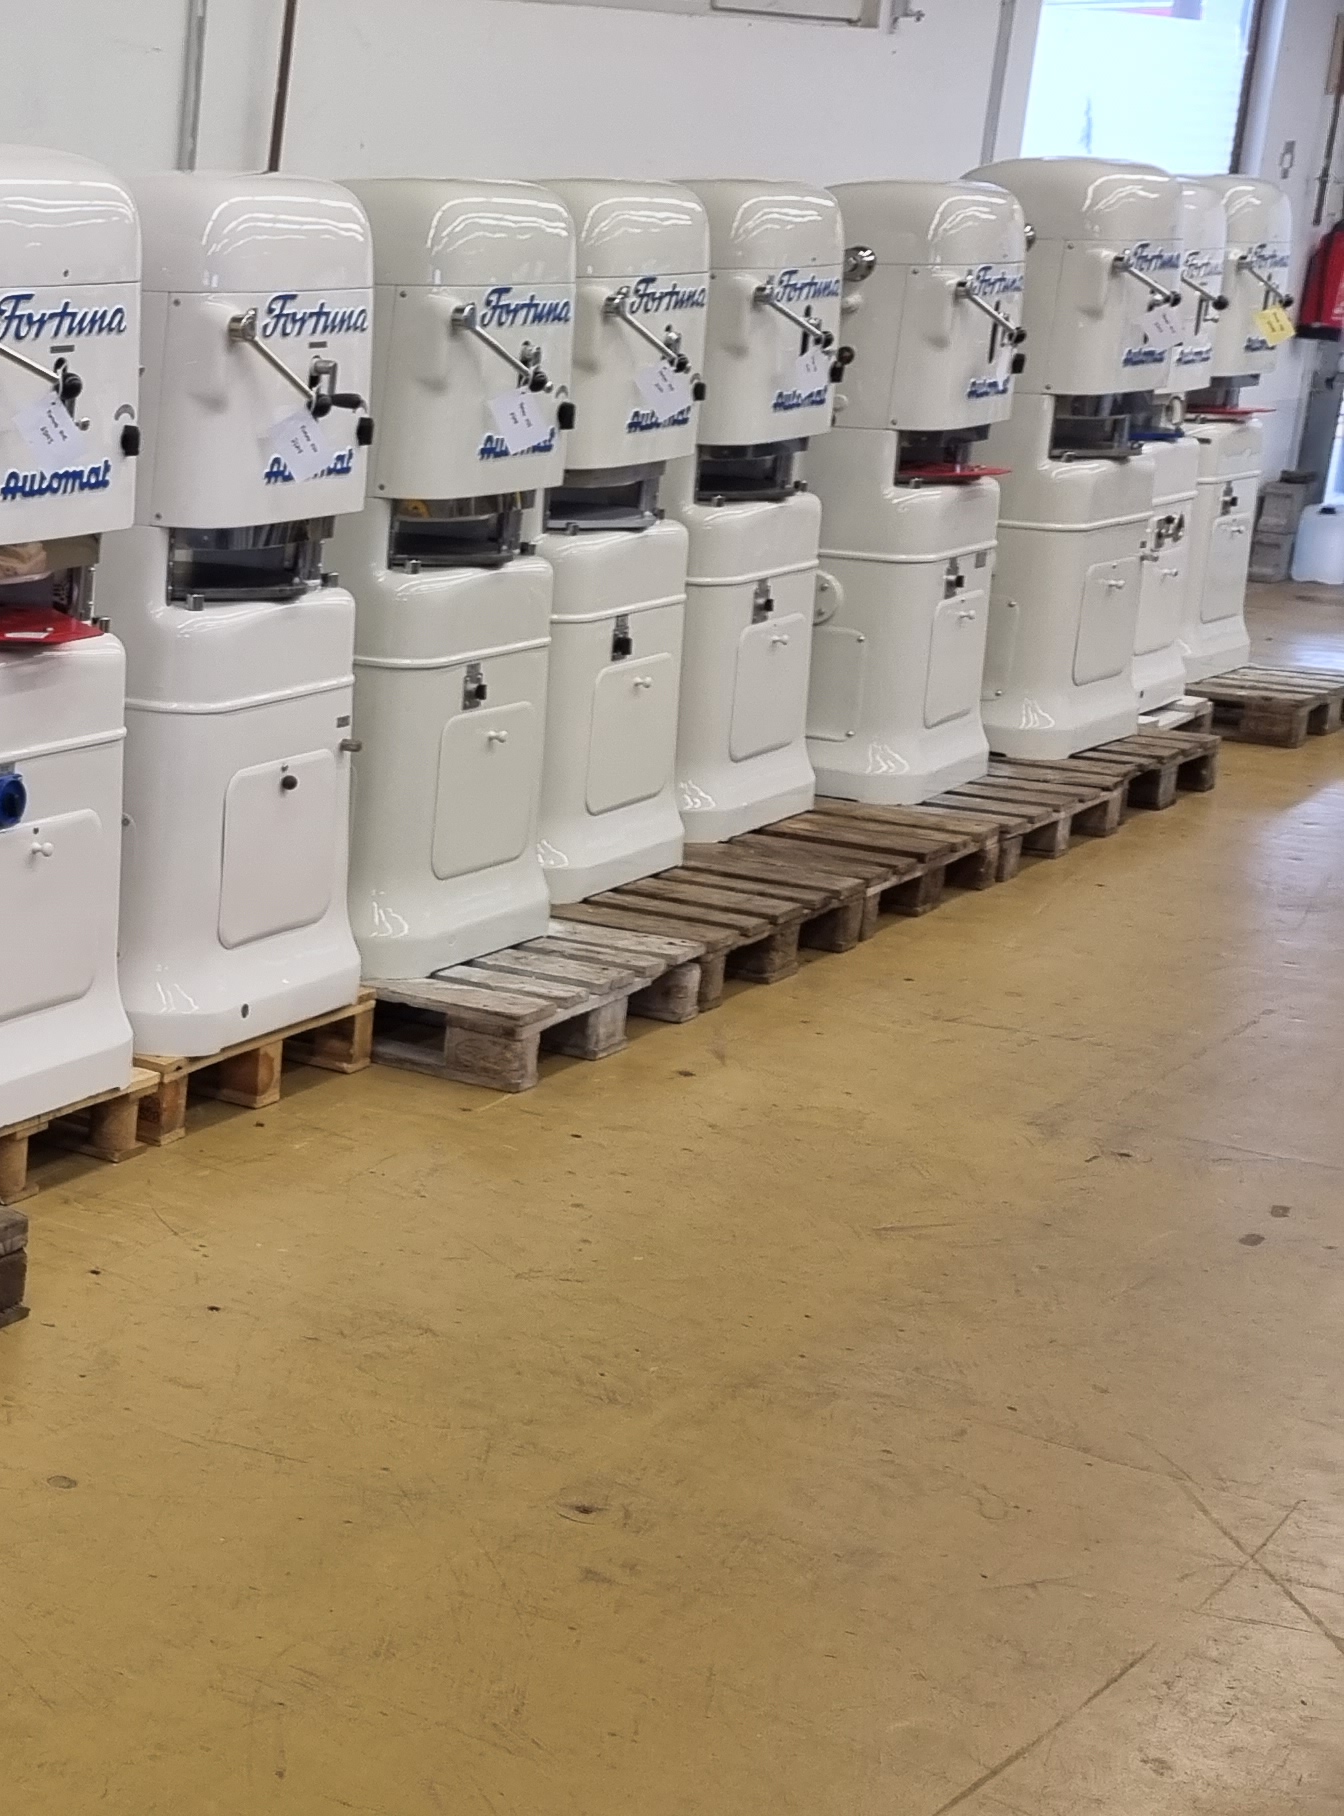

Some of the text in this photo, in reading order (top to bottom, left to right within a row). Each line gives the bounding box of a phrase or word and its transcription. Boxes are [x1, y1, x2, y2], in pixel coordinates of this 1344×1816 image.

[630, 277, 706, 314] Fortuna
[774, 269, 839, 302] Fortuna
[263, 294, 369, 338] Fortuna
[481, 287, 570, 327] Fortuna
